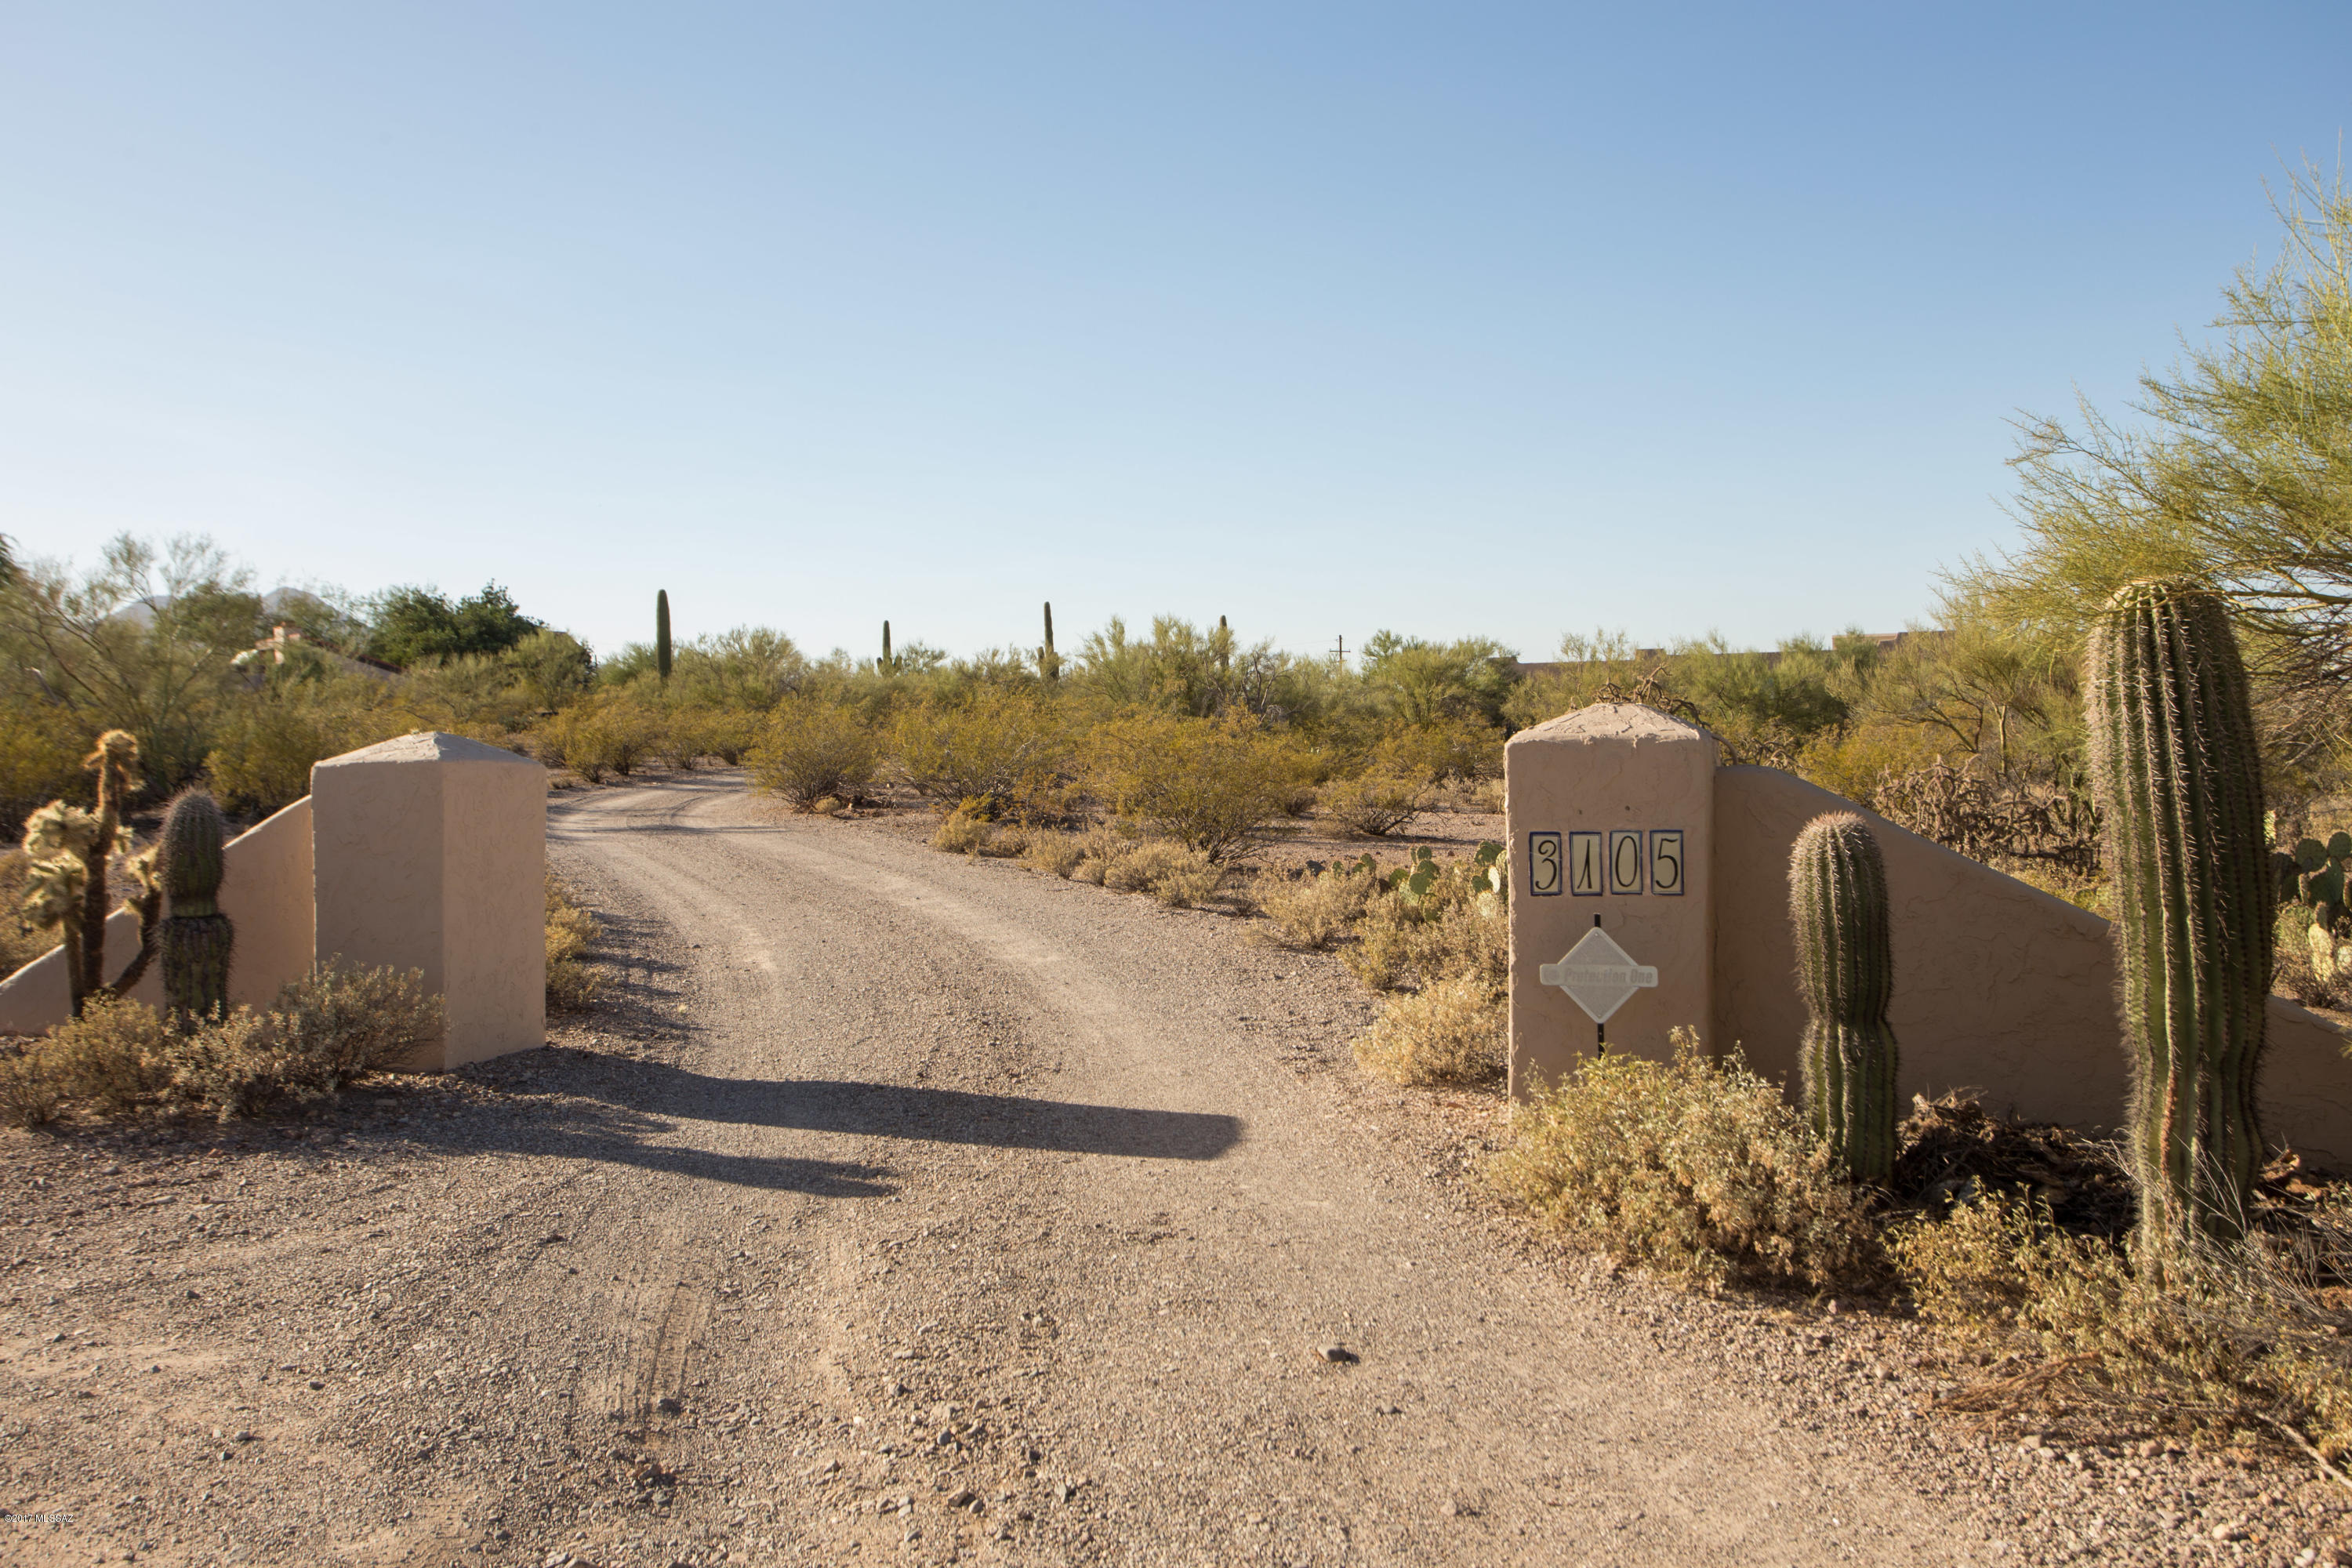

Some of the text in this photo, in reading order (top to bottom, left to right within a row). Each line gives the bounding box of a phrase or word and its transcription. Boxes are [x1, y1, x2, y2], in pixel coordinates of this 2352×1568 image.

[1535, 836, 1679, 890] 3105
[1564, 967, 1653, 984] Protection One
